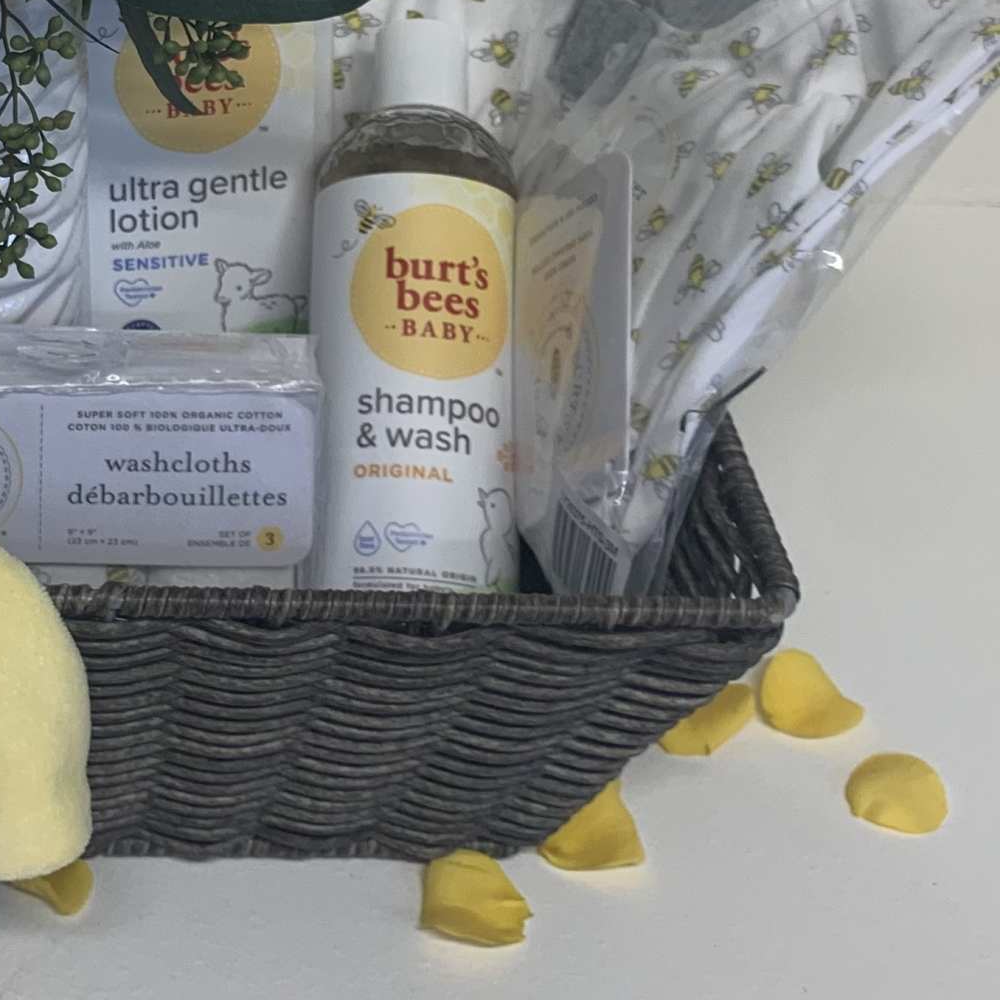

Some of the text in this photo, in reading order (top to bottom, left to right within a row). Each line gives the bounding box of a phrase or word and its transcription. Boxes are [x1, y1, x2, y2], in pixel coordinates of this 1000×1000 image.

[167, 98, 234, 119] BBY
[109, 165, 288, 203] ultra gentle
[110, 205, 199, 234] lotion
[112, 253, 209, 272] SENSITIVE
[385, 246, 489, 291] burt's
[396, 280, 480, 320] bees
[401, 318, 474, 344] BABY
[77, 410, 284, 420] SUPER SOFT 100% ORGANIC COTTON
[357, 387, 500, 428] shampoo
[67, 423, 106, 432] COTON
[110, 423, 130, 432] 100
[145, 424, 216, 433] BIOLOGIQUE
[219, 423, 292, 432] ULTRA-DOUX
[356, 422, 471, 455] & wash
[104, 450, 252, 474] washcloths
[353, 463, 454, 483] ORIGINAL
[66, 483, 289, 507] débarbouillettes
[264, 531, 276, 546] 3
[387, 566, 438, 578] NATURAL
[441, 570, 478, 583] ORIGIN
